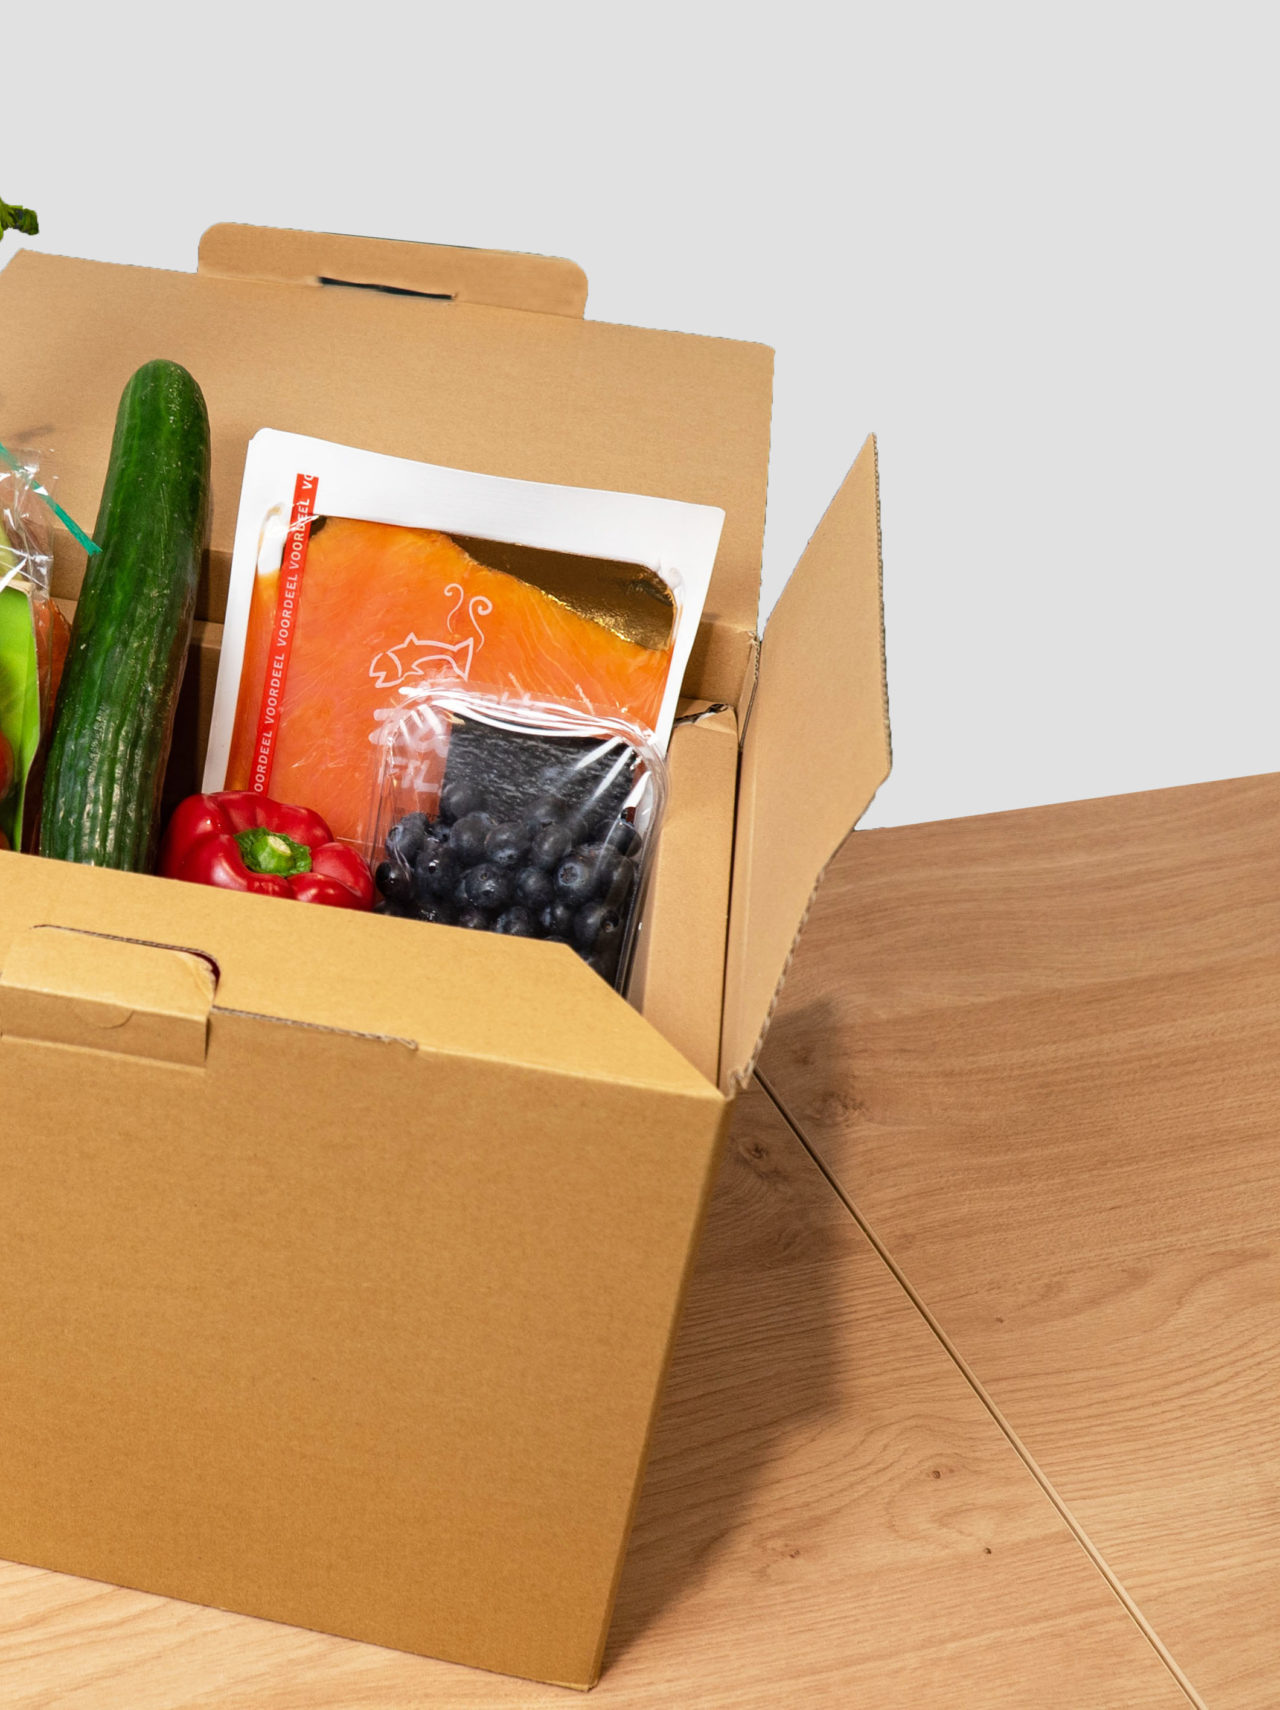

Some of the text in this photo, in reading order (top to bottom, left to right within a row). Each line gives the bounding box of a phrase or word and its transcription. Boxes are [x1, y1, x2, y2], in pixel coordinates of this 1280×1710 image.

[253, 730, 273, 793] OORDEEL
[264, 653, 285, 725] VOORDEEL
[277, 574, 298, 647] VOORDEEL
[289, 498, 310, 570] VOORDEEL
